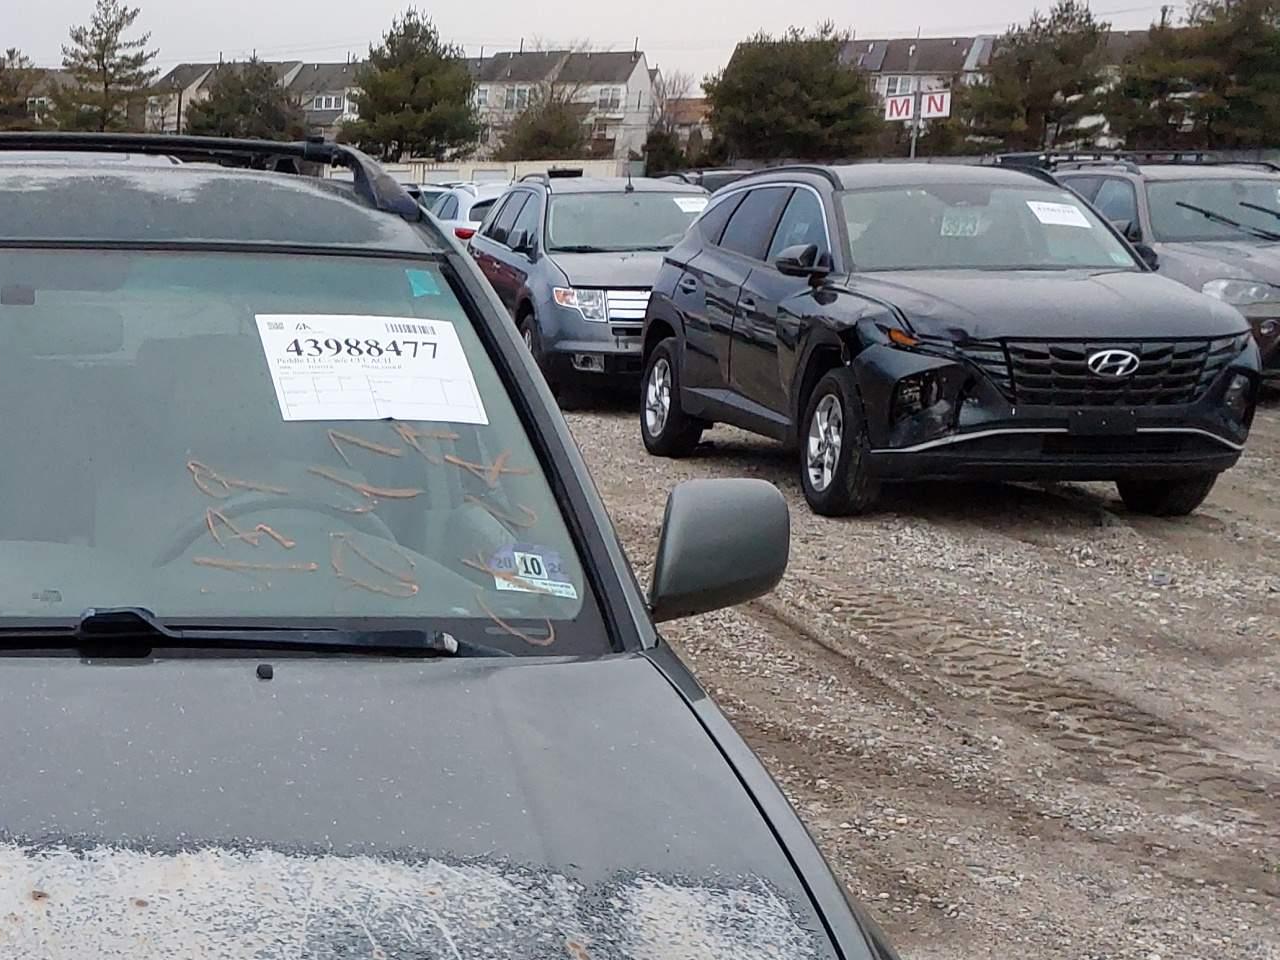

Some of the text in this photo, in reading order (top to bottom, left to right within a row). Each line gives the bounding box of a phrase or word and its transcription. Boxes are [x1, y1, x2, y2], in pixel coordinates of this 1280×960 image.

[889, 95, 945, 117] M N
[286, 337, 438, 359] 43988477
[519, 556, 542, 576] 10
